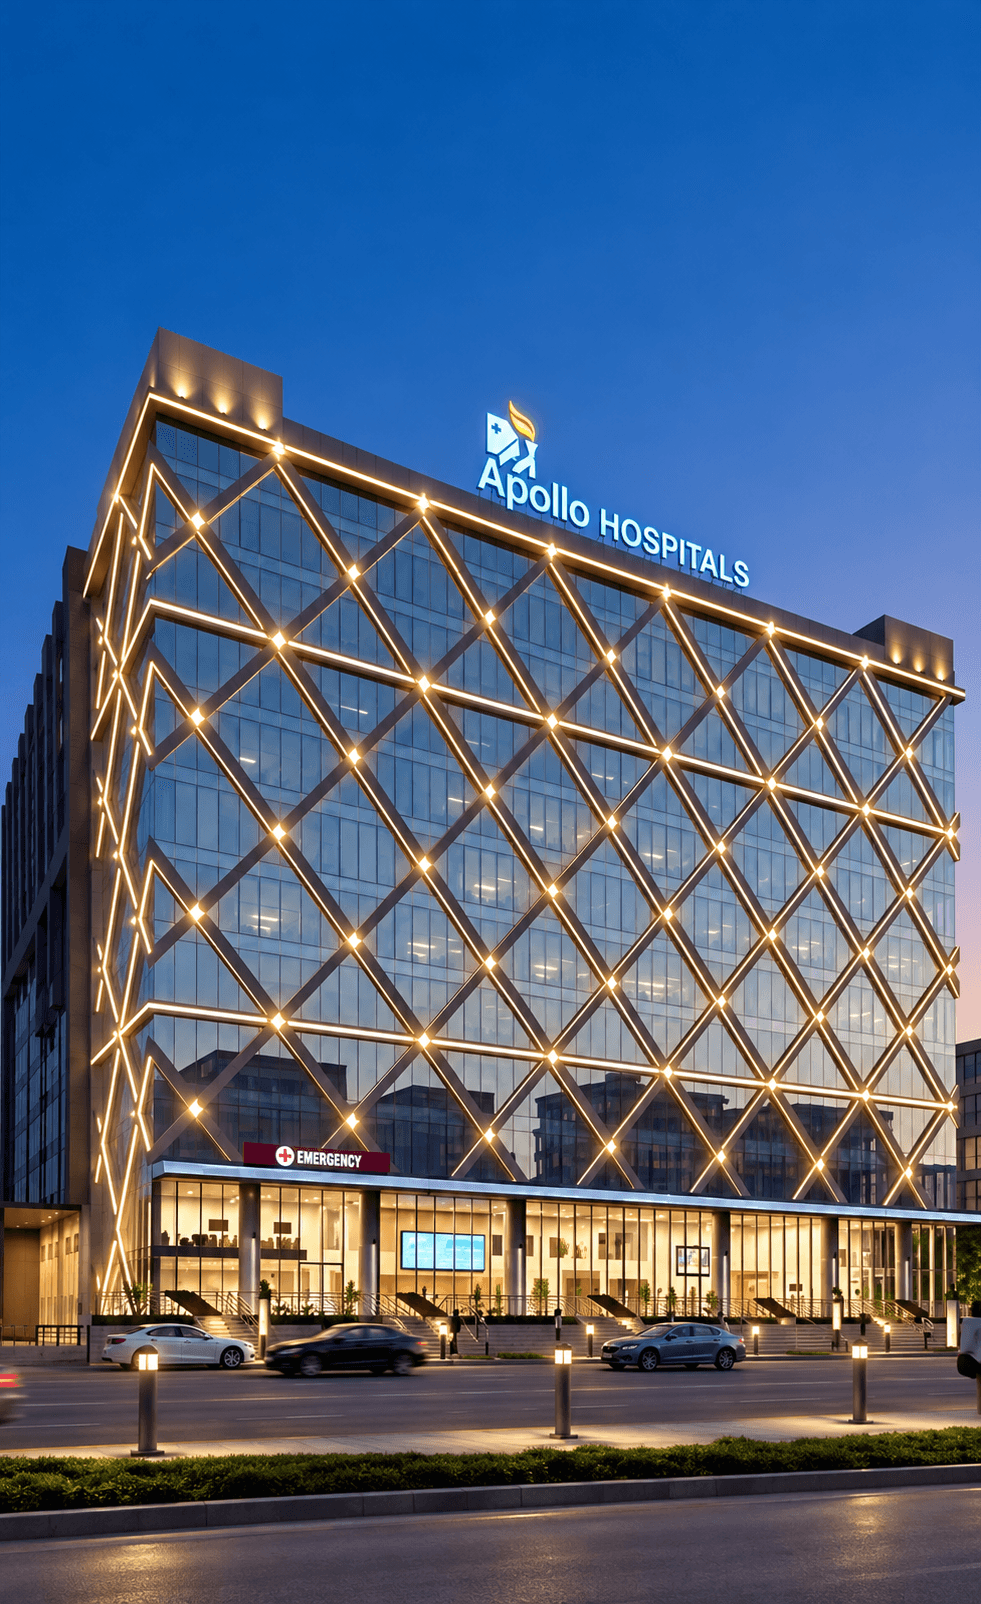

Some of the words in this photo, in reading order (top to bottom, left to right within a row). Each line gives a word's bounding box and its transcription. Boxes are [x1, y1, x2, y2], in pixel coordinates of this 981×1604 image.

[477, 457, 590, 528] Apollo
[600, 508, 750, 588] HOSPITALS
[297, 1150, 362, 1168] EMERGENCY
